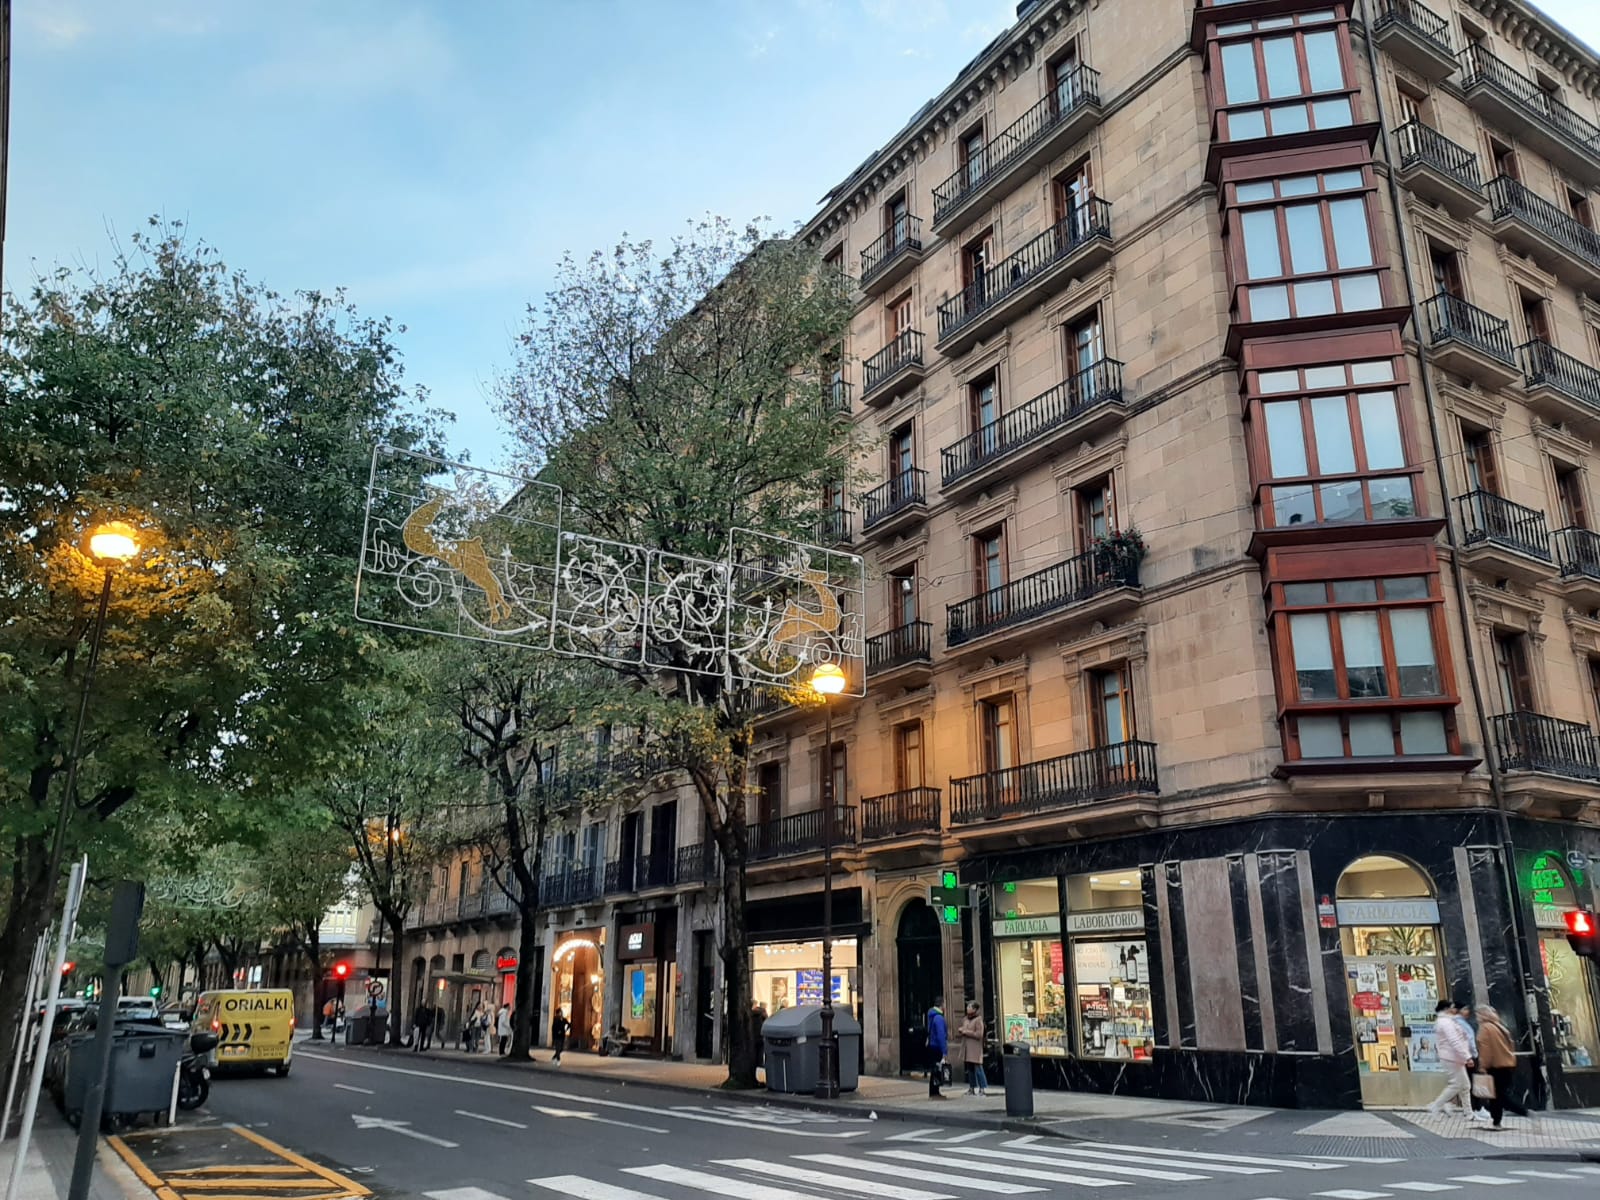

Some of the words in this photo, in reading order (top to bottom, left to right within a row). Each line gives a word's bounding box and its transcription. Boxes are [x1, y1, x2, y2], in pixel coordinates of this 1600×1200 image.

[1347, 905, 1430, 920] FARMACIA
[1004, 919, 1048, 934] FARMACIA
[1073, 913, 1138, 929] LABORATORIO
[225, 998, 288, 1011] ORIALKI
